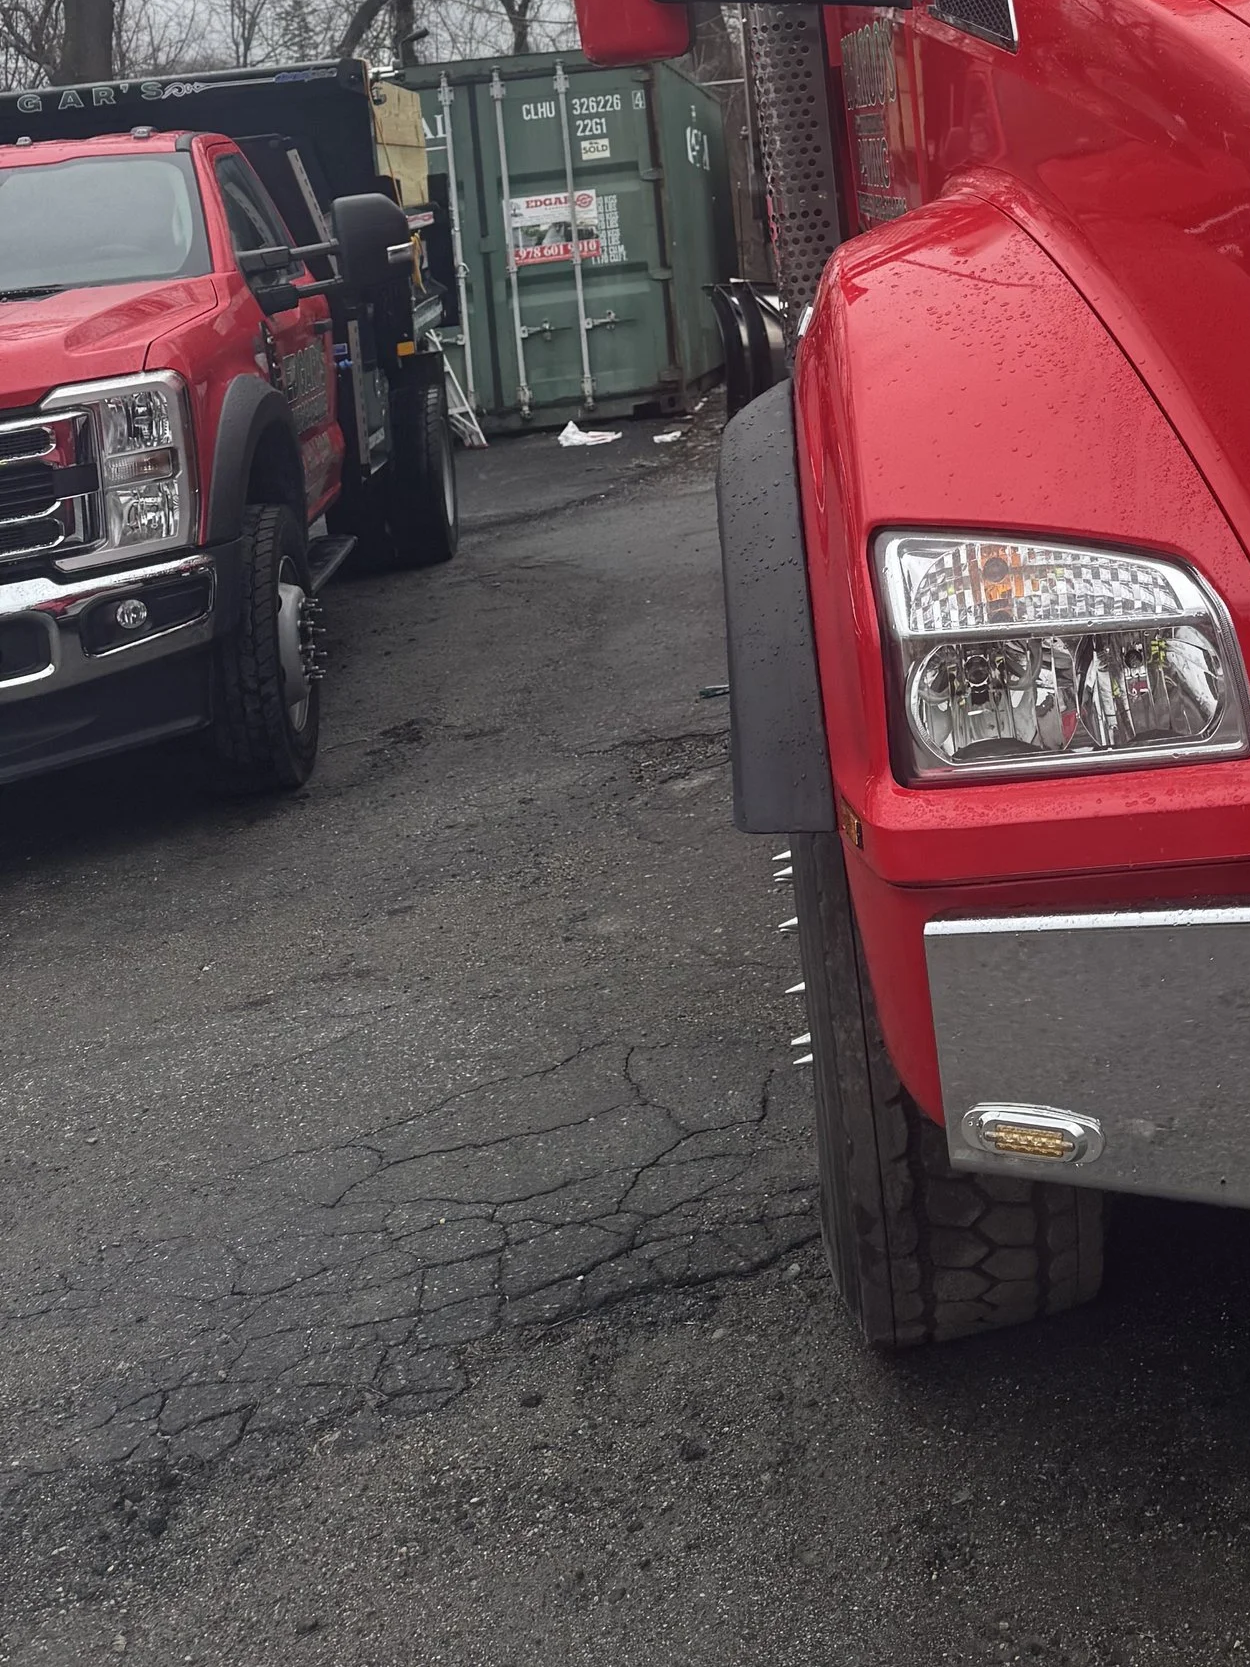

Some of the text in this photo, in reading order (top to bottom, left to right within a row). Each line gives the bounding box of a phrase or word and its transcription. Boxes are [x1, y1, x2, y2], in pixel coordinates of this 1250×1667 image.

[522, 90, 646, 120] CLHU 326226 4
[576, 117, 607, 137] 22G1
[582, 144, 609, 155] SOLD
[519, 246, 542, 260] 978
[543, 243, 564, 257] 601
